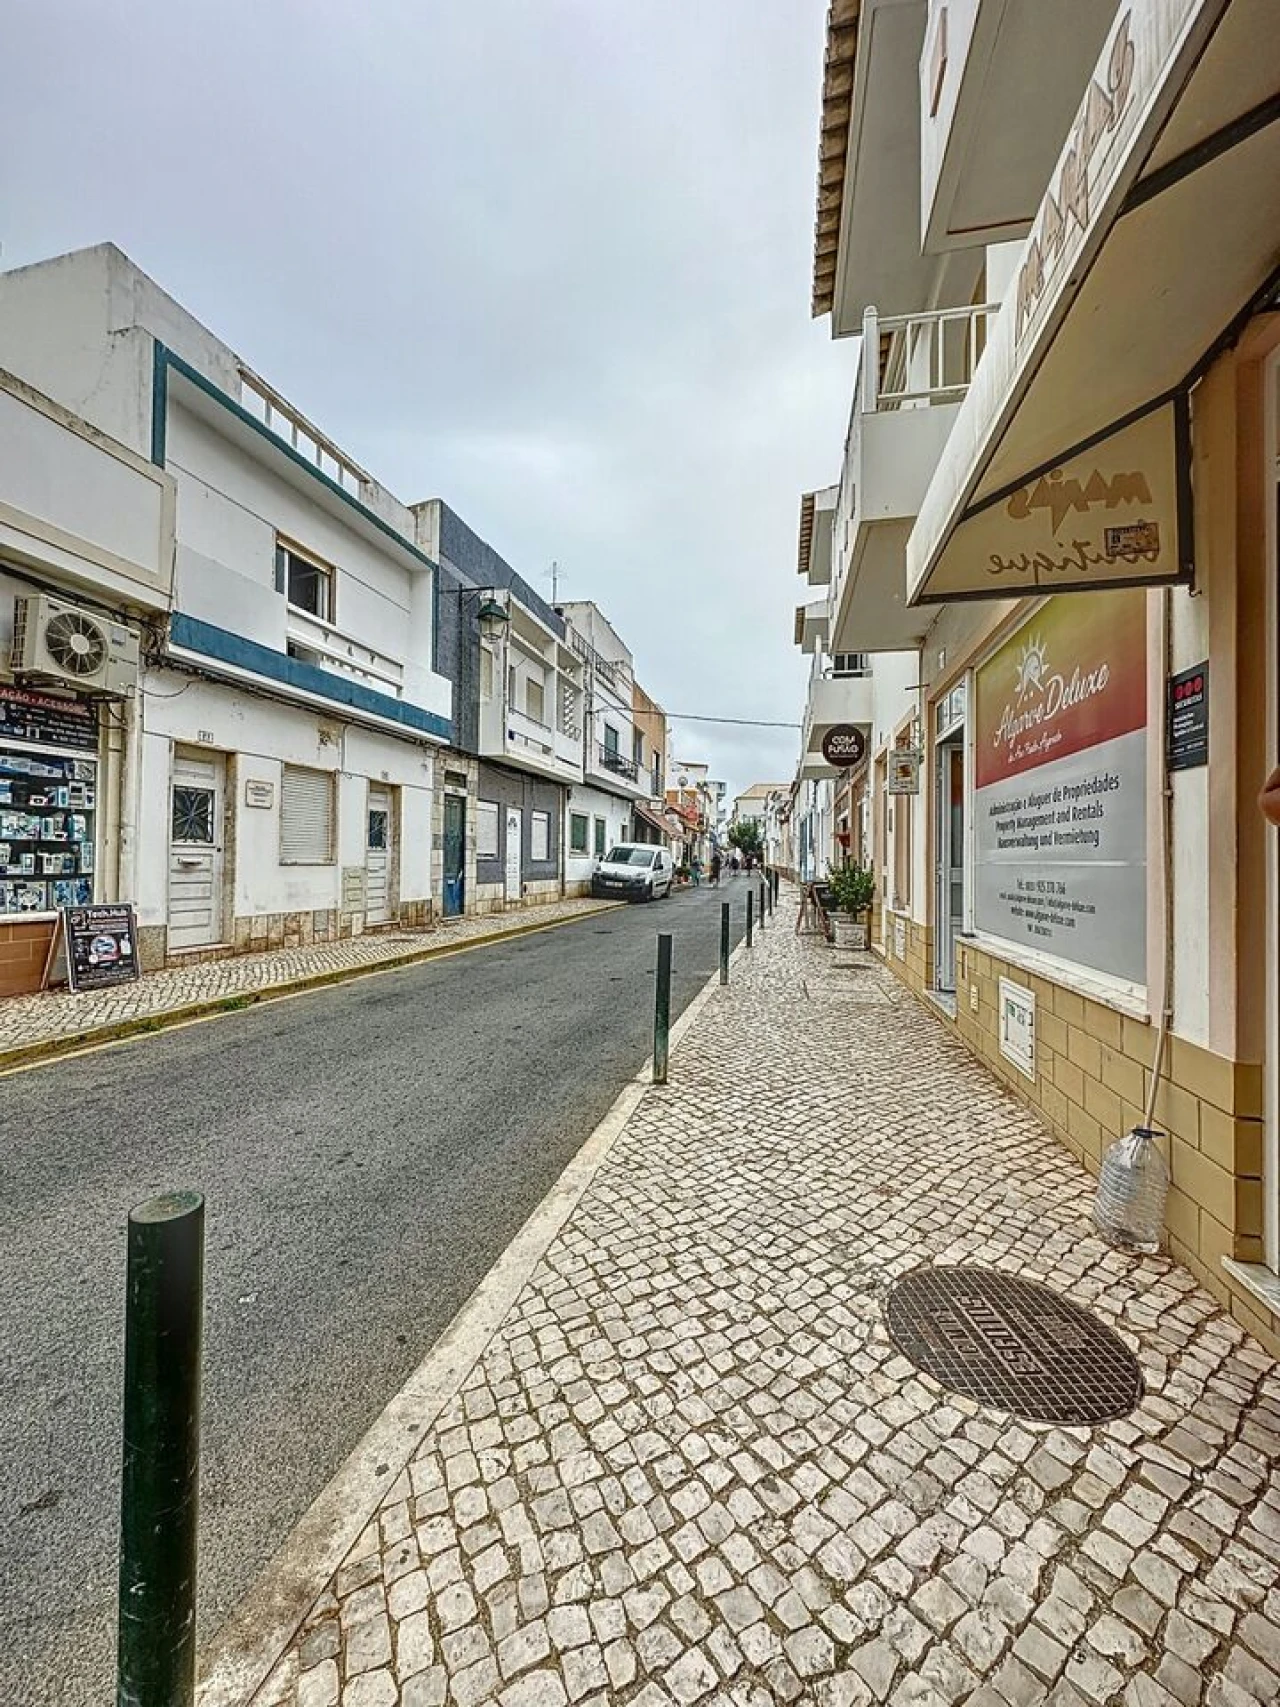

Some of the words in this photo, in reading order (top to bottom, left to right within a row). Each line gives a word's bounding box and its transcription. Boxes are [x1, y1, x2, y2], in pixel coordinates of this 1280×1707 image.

[1044, 663, 1110, 720] Deluxe
[1052, 787, 1062, 802] de
[1062, 773, 1119, 802] Propriedades
[1055, 806, 1071, 823] and
[1072, 800, 1104, 820] Rentals
[1039, 831, 1054, 845] und
